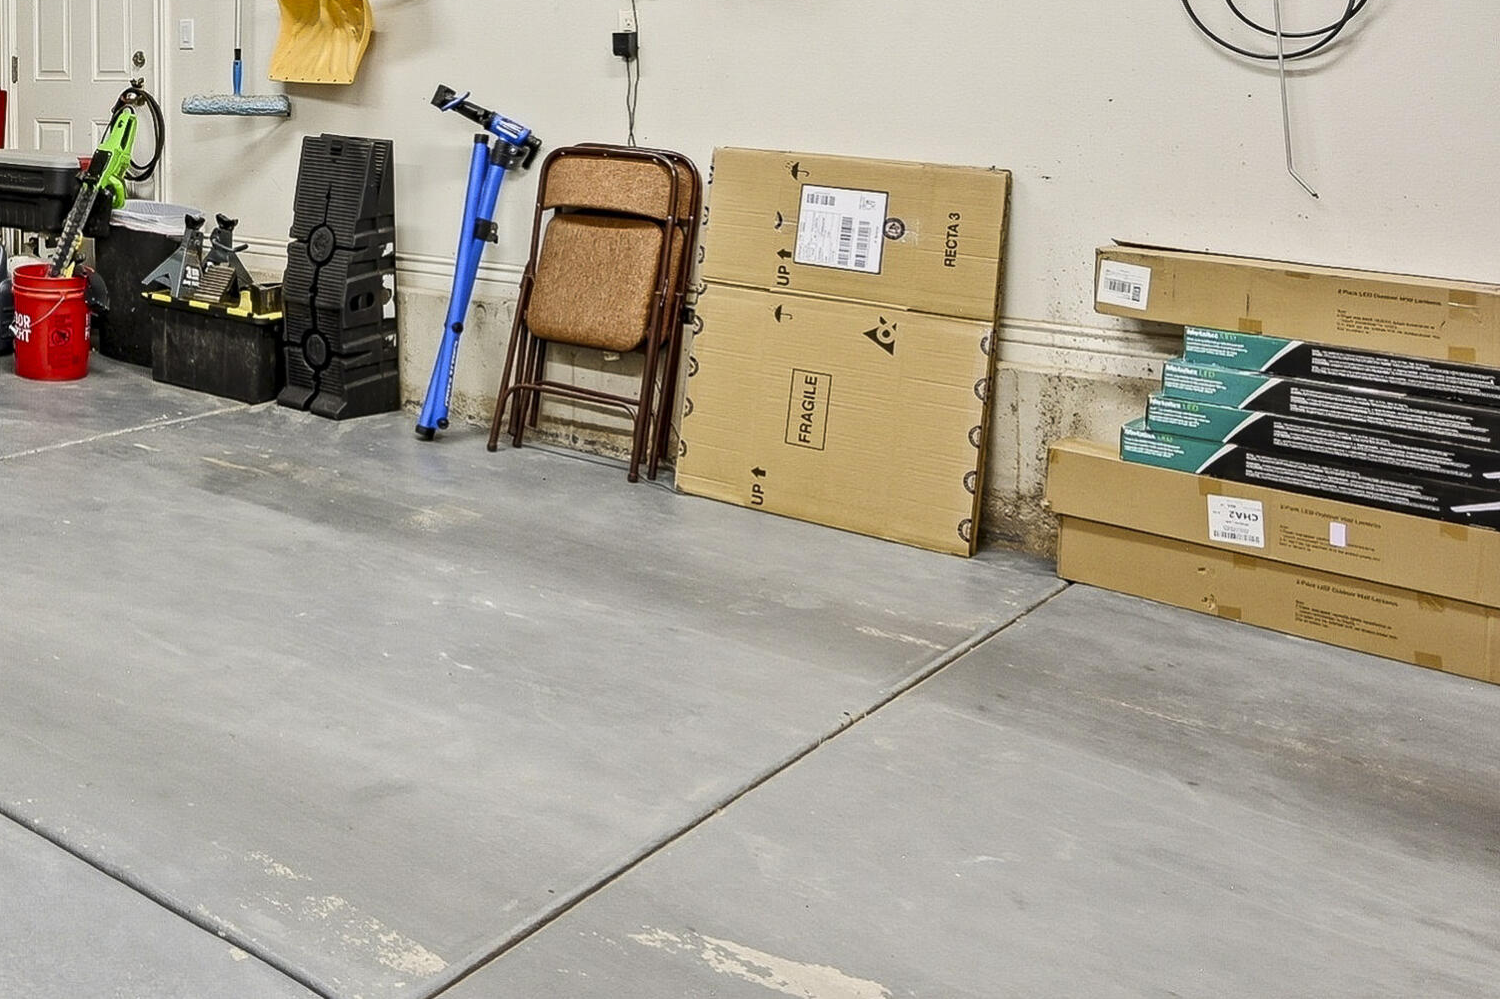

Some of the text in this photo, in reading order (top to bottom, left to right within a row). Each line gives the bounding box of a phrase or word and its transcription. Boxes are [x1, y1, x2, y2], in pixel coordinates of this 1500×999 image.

[944, 212, 962, 268] RECTA 3
[776, 265, 791, 287] UP
[798, 374, 818, 444] FRAGILE
[750, 483, 765, 506] UP
